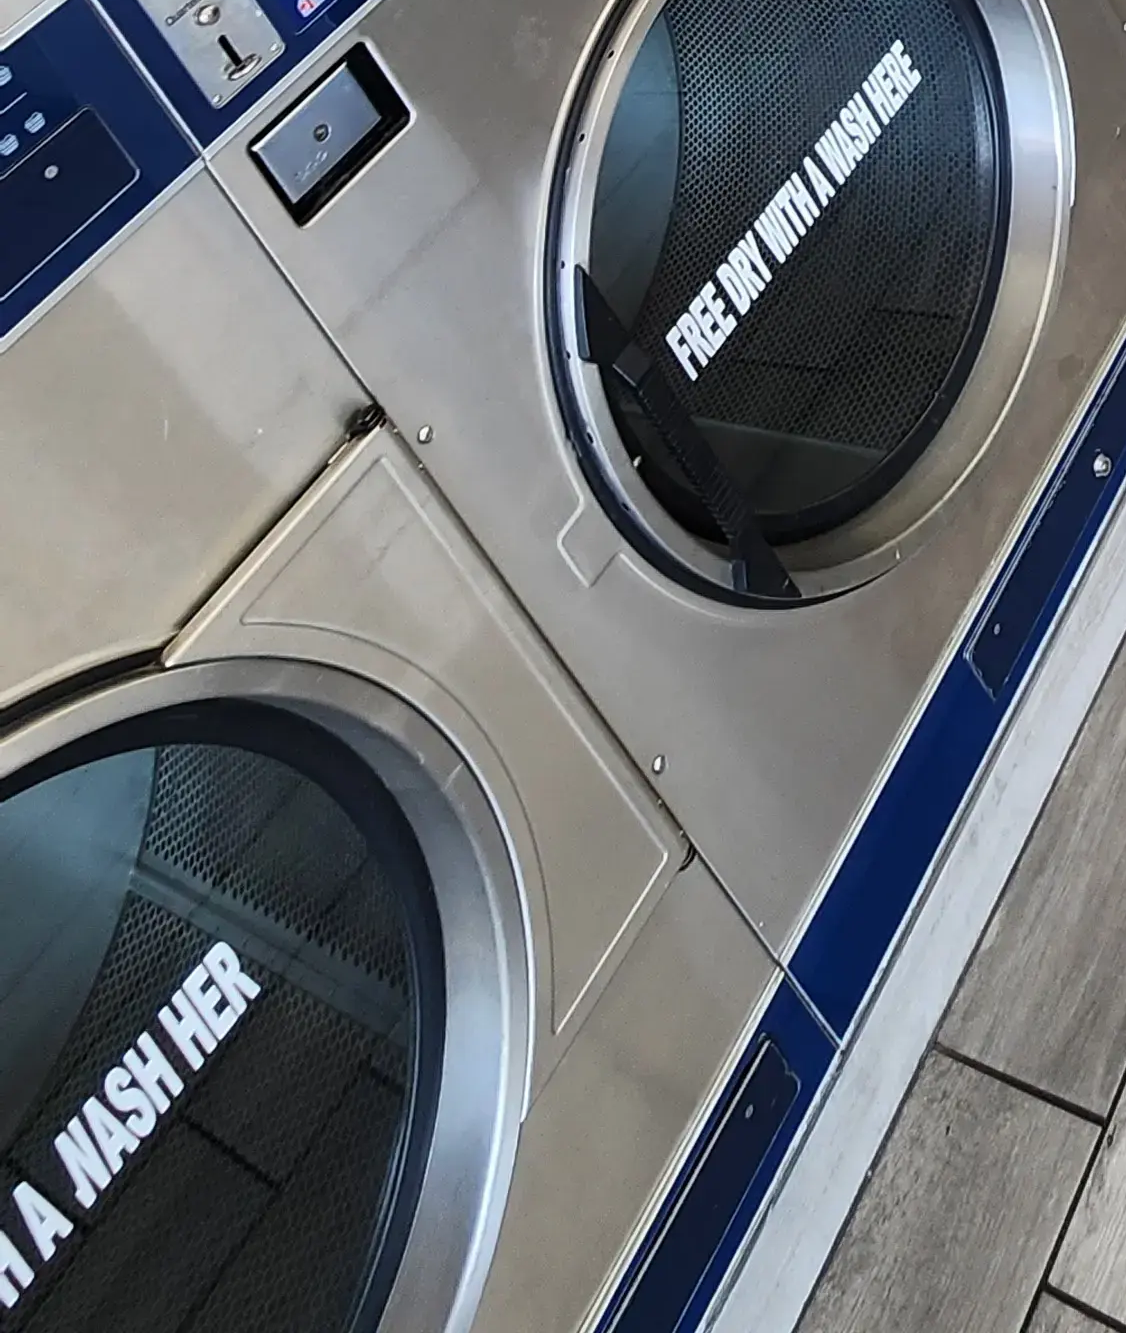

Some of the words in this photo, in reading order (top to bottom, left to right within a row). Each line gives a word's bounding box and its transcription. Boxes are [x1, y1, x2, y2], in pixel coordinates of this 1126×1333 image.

[861, 38, 923, 127] HERE
[802, 155, 836, 208] A
[814, 91, 882, 186] WASH
[753, 171, 821, 265] WITH
[715, 229, 772, 317] DRY
[664, 280, 738, 382] FREE
[12, 1180, 74, 1262] A
